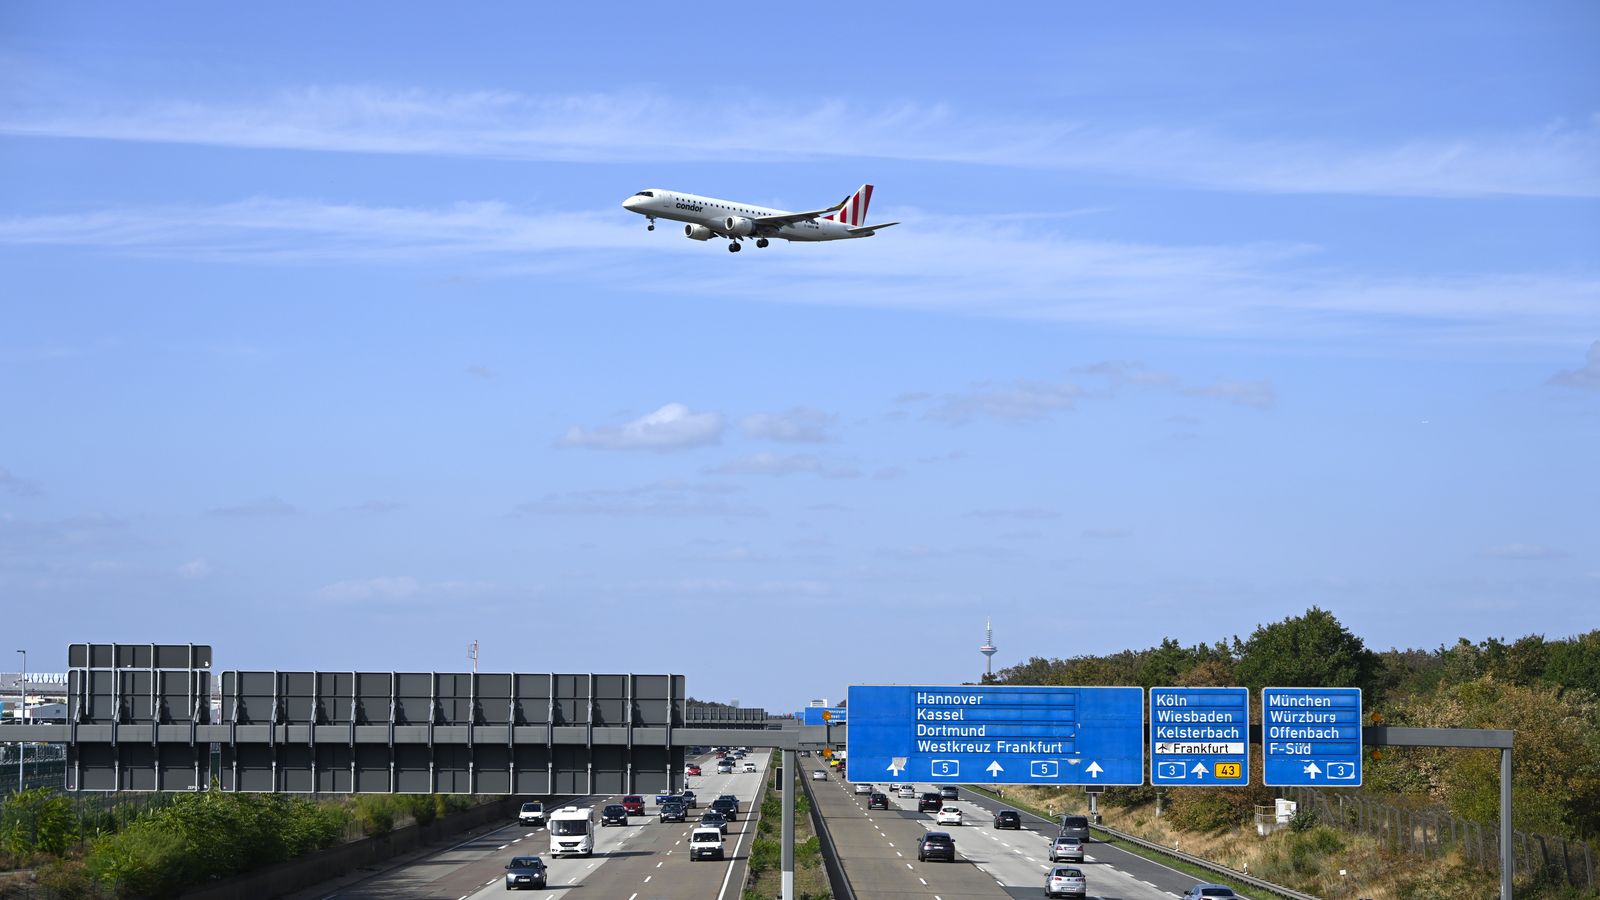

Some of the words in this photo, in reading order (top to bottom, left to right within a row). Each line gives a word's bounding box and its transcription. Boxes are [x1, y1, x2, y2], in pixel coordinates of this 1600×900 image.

[676, 202, 703, 212] condor
[917, 692, 984, 705] Hannover
[1156, 694, 1187, 707] Köln
[1269, 694, 1331, 707] München
[917, 708, 965, 721] Kassel
[1157, 710, 1232, 723] Wiesbaden
[1270, 710, 1336, 723] Würzburg
[917, 724, 986, 737] Dortmund
[1157, 726, 1239, 739] Kelsterbach
[1269, 726, 1339, 739] Offenbach
[917, 740, 991, 753] Westkreuz
[997, 740, 1063, 753] Frankfurt
[1172, 743, 1229, 754] Frankfurt
[1269, 742, 1311, 755] F-Süd
[942, 762, 949, 774] 5
[1041, 763, 1048, 774] 5
[1168, 765, 1176, 776] 3
[1221, 765, 1235, 776] 43
[1337, 765, 1345, 776] 3
